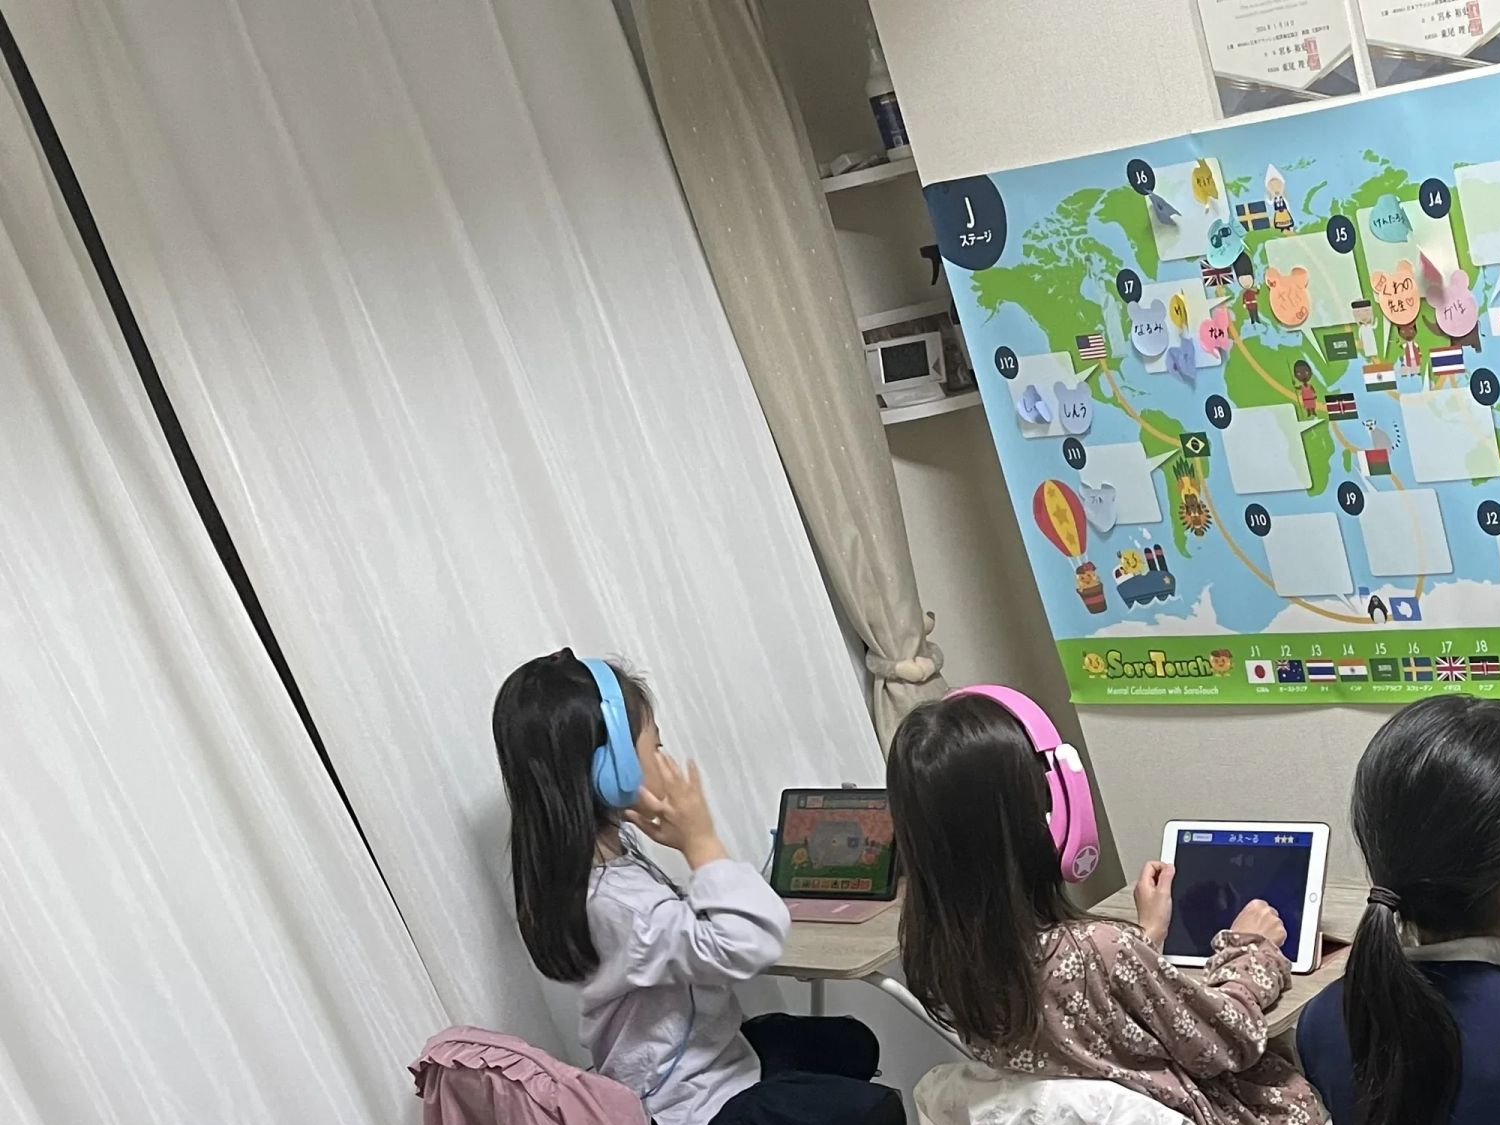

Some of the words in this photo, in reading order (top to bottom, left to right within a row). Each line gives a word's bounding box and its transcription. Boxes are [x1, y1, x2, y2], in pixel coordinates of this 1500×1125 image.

[1135, 171, 1148, 184] J6
[1428, 191, 1442, 207] J4
[964, 197, 976, 229] J
[959, 230, 992, 247] ステージ
[1335, 227, 1348, 241] J5
[1124, 281, 1134, 294] J7
[1000, 357, 1015, 370] J12
[1479, 380, 1492, 394] J3
[1213, 405, 1225, 419] J8
[1068, 448, 1081, 460] J11
[1346, 492, 1356, 505] J9
[1250, 514, 1267, 527] J10
[1486, 511, 1498, 525] J2
[1251, 645, 1261, 657] J1
[1281, 645, 1291, 657] J2
[1311, 644, 1322, 657] J3
[1343, 643, 1354, 656] J4
[1375, 642, 1387, 655] J5
[1408, 642, 1420, 654] J6
[1441, 641, 1453, 654] J7
[1475, 640, 1488, 653] J8
[1106, 649, 1213, 679] SoroTouch
